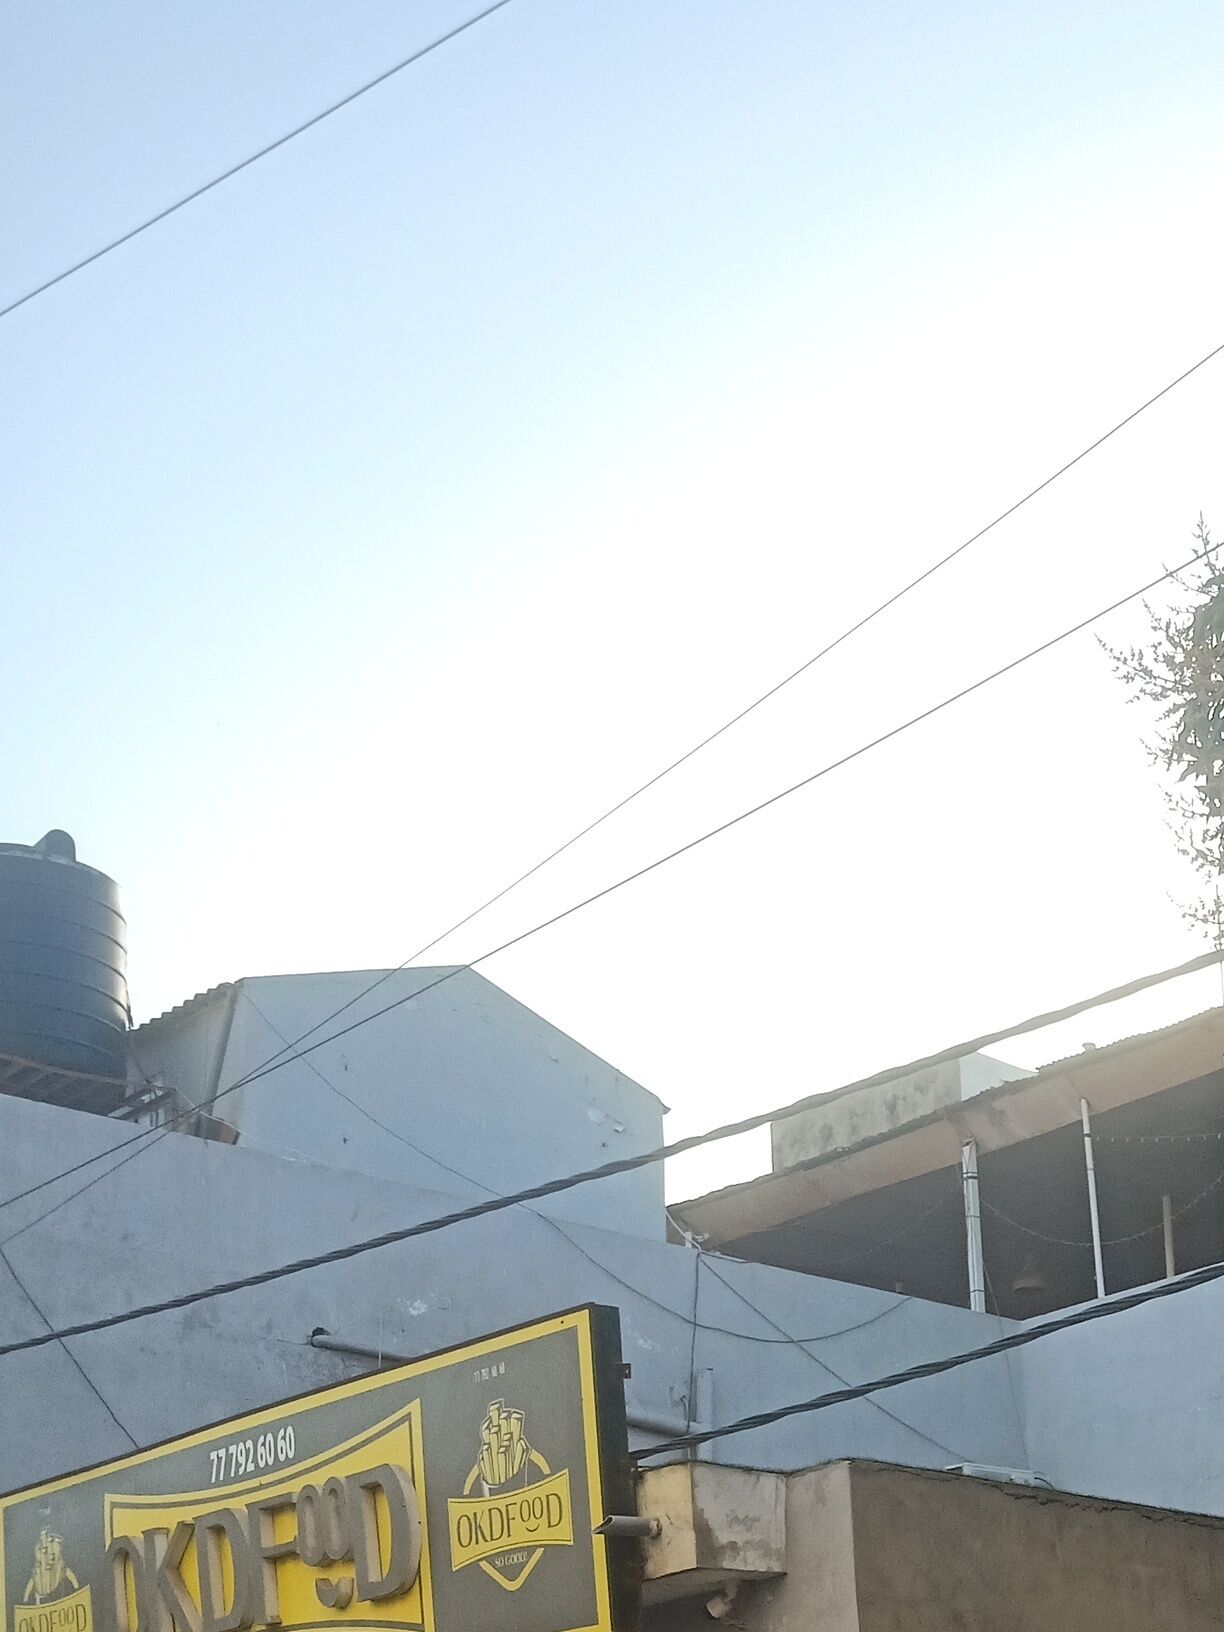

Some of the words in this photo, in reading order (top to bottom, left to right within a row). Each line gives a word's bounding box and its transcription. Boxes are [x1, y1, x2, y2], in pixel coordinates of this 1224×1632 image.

[209, 1448, 226, 1484] 77
[228, 1439, 255, 1478] 792
[257, 1432, 275, 1468] 60
[277, 1425, 295, 1462] 60
[456, 1492, 563, 1548] OKDFOOD
